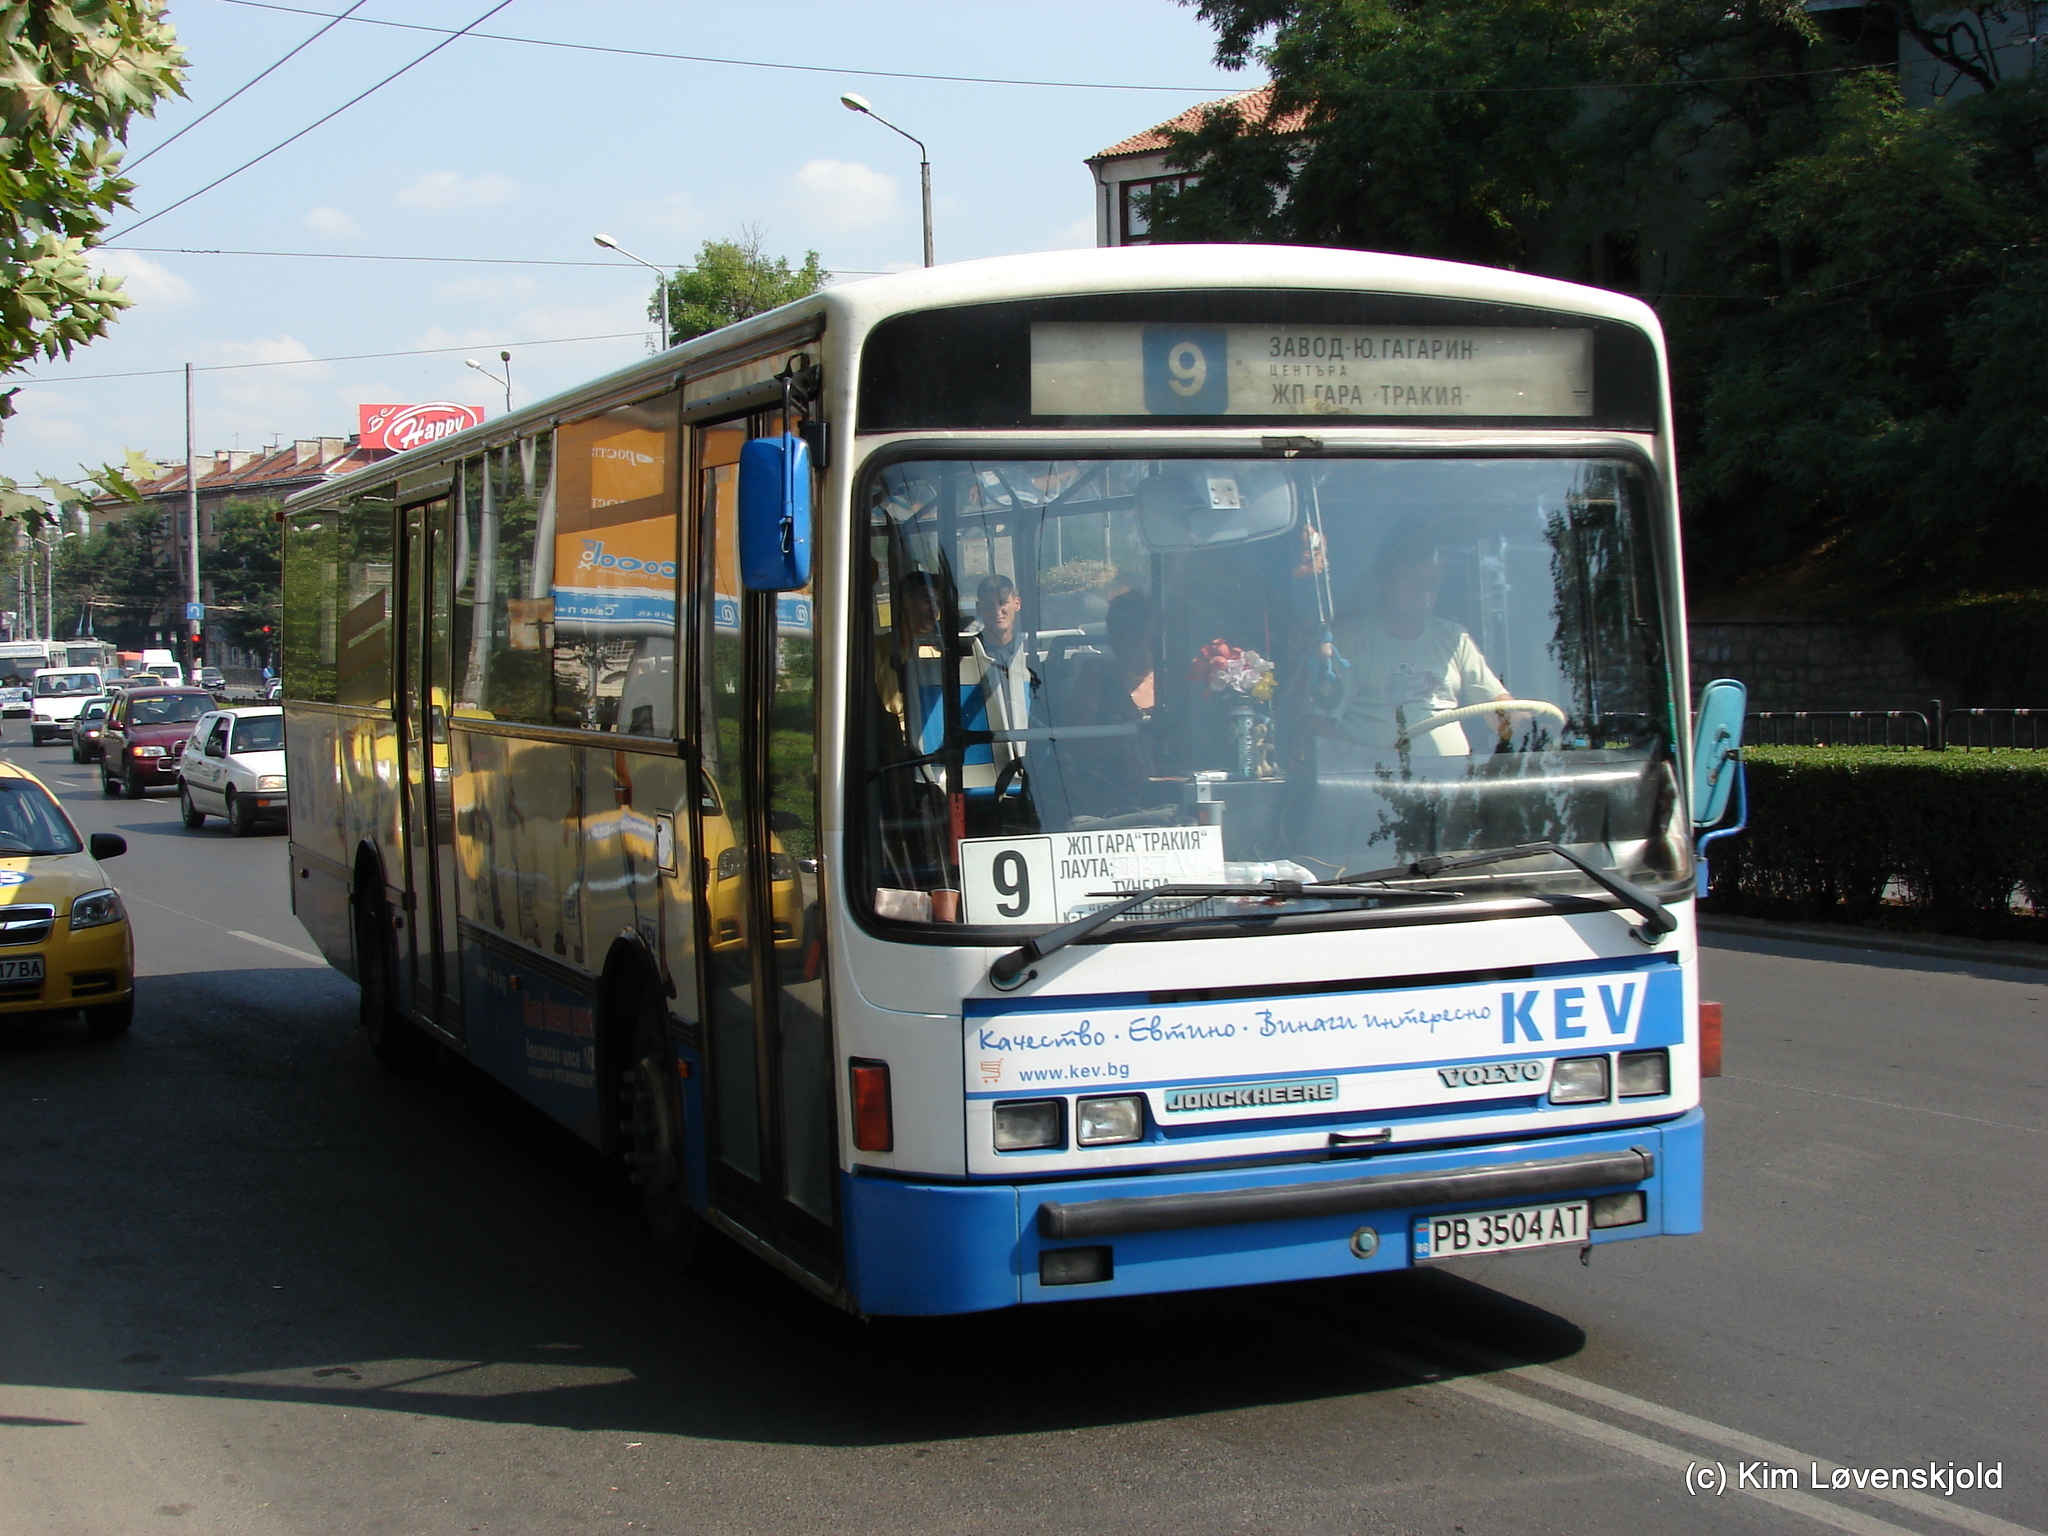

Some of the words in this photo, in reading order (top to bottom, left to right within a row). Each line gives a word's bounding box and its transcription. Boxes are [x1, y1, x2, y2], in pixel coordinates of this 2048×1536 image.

[1269, 337, 1344, 361] ЗАВОД
[1168, 341, 1207, 397] 9
[1269, 364, 1348, 377] ЦЕНТЪРА
[1272, 383, 1305, 405] ЖП
[1314, 384, 1363, 406] ГАРА
[365, 406, 396, 434] Be
[394, 415, 466, 449] Happy
[1067, 835, 1093, 855] ЖП
[992, 849, 1031, 918] 9
[1501, 982, 1637, 1044] KEV
[979, 1020, 1105, 1051] Качество
[1128, 1015, 1235, 1042] Евтино
[1255, 1008, 1358, 1036] Винаги
[1362, 1005, 1491, 1033] интересно
[1019, 1062, 1130, 1083] www.kev.bg
[1438, 1060, 1545, 1088] VOLVO
[1166, 1083, 1336, 1111] JONCKHEERE
[1477, 1210, 1543, 1247] 3504
